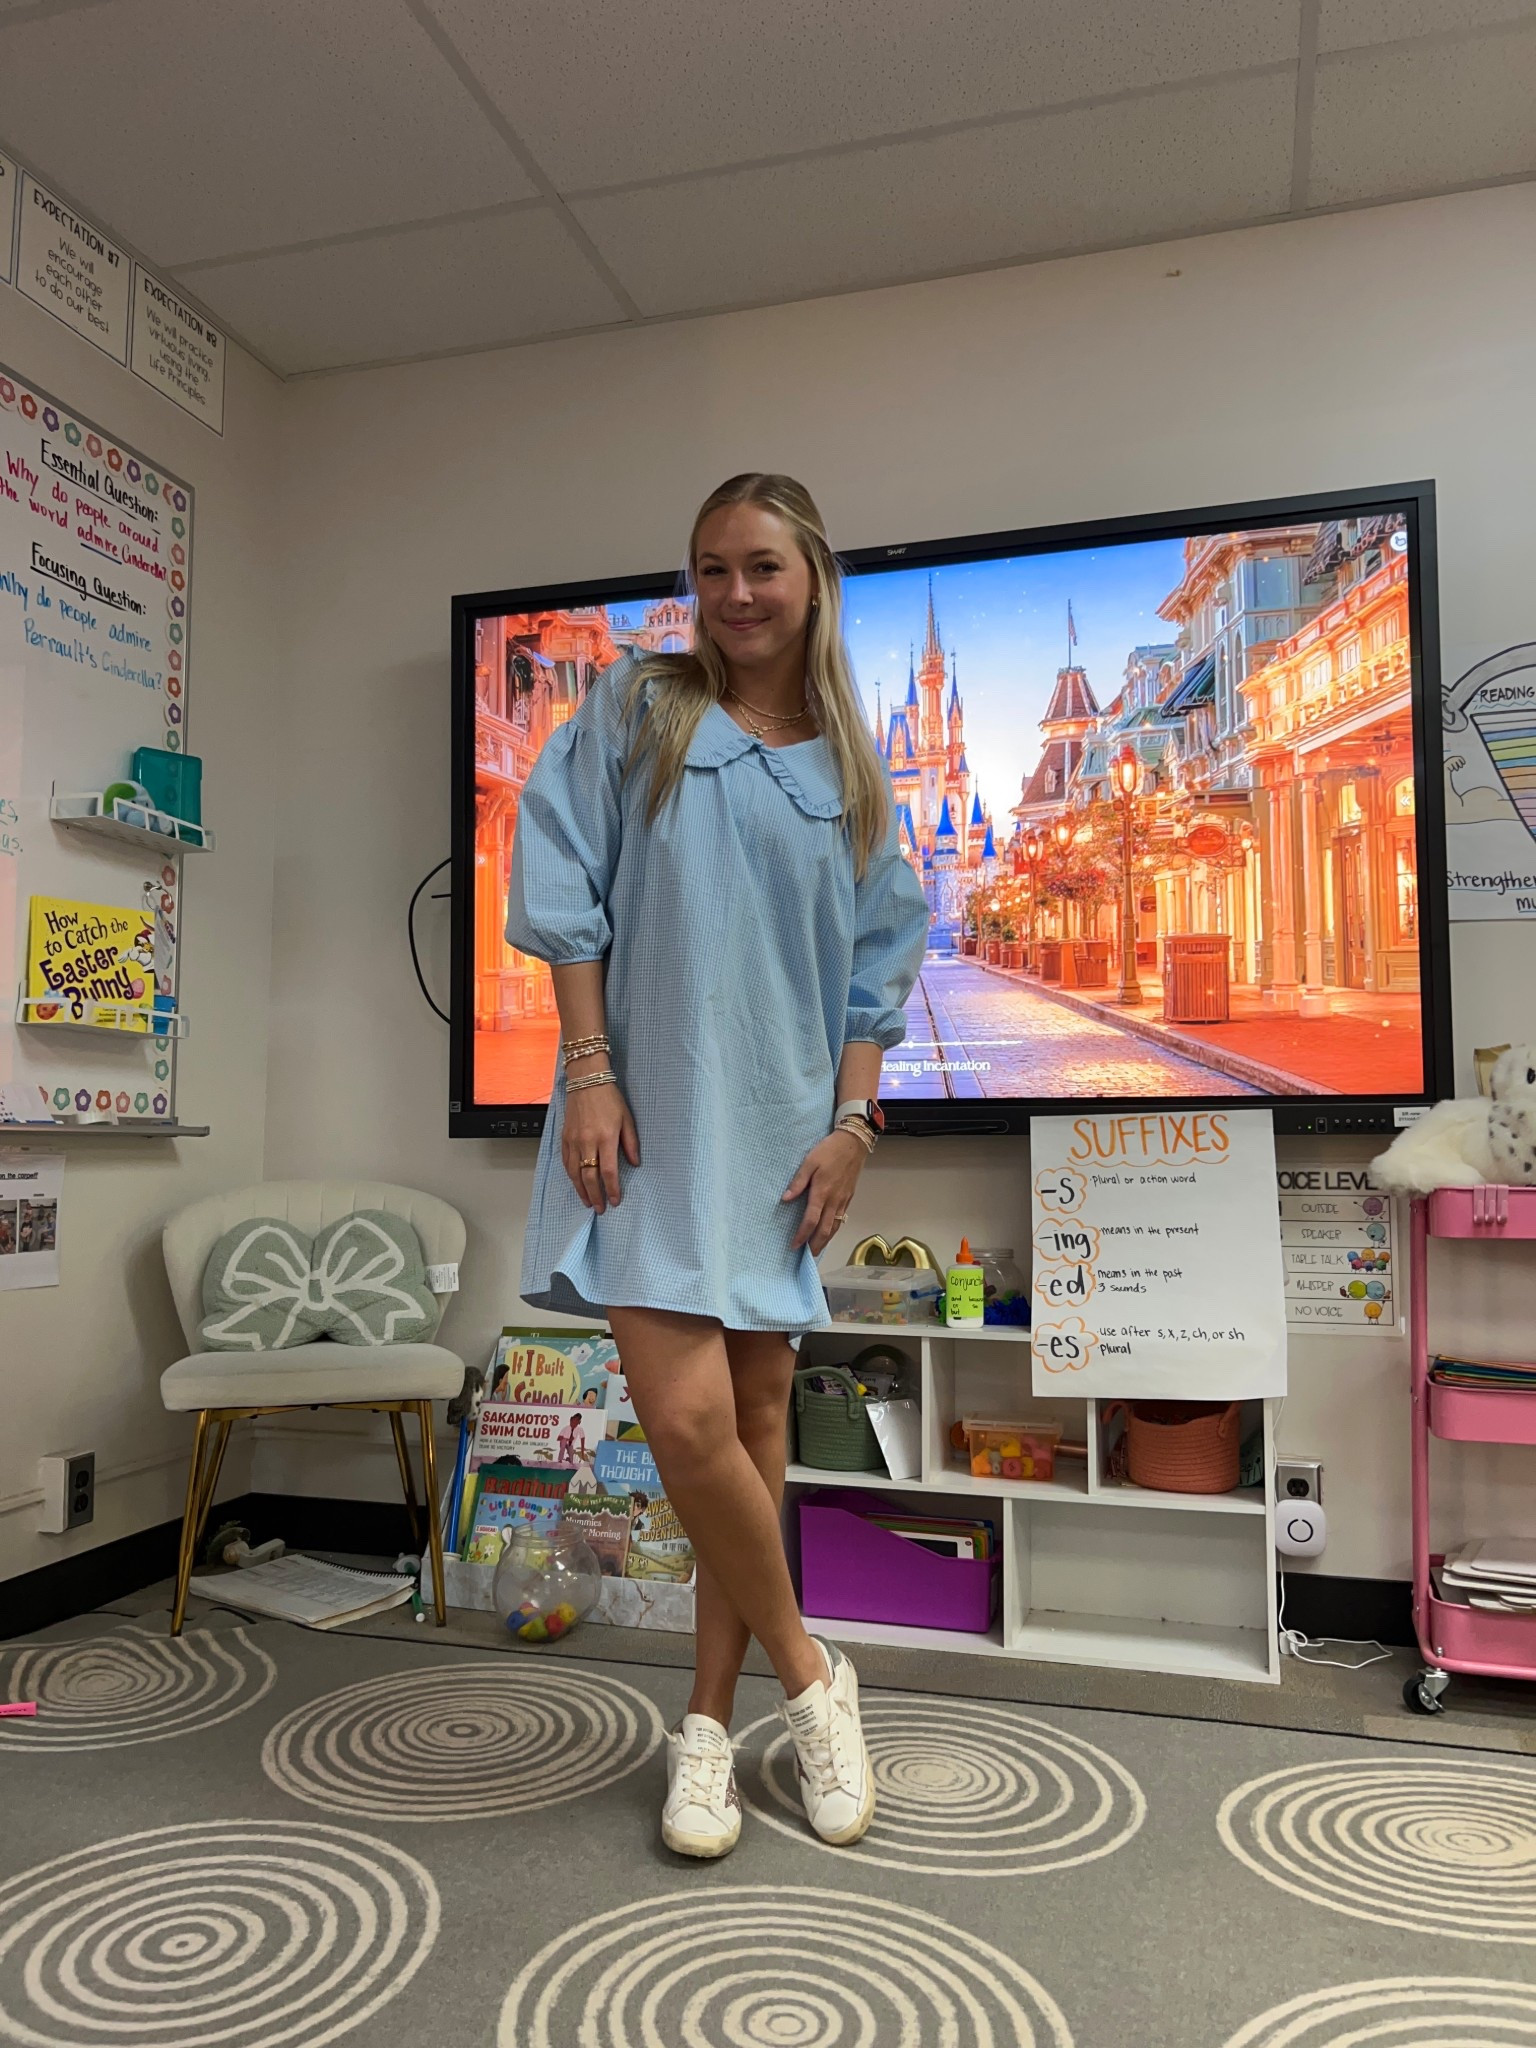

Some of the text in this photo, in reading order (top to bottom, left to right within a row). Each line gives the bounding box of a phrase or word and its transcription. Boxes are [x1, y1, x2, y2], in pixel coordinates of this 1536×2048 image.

[33, 188, 120, 268] EXPECTATION #7
[59, 236, 94, 274] We will
[48, 249, 102, 297] encourage
[46, 264, 102, 312] each other
[35, 269, 109, 334] to do our best
[144, 278, 217, 348] EXPECTATION #8
[147, 305, 213, 367] We will practice
[149, 327, 185, 361] virtuous
[159, 349, 199, 385] using the
[149, 354, 205, 405] Life Principles
[41, 438, 158, 523] Essential Question:
[6, 450, 159, 553] Why do people around
[0, 476, 166, 581] the world admire Cinderella?
[887, 547, 907, 556] SMART
[32, 541, 147, 616] Focusing Question:
[0, 571, 152, 652] Why do people admire
[24, 617, 162, 690] Perrault's Cinderella?
[1480, 685, 1535, 704] READING
[1447, 870, 1536, 896] Strengthe
[44, 910, 78, 935] How
[44, 916, 129, 956] to Catch the
[39, 946, 118, 991] Easter
[63, 966, 134, 1020] Bunny
[923, 1060, 991, 1071] Incantation
[1070, 1114, 1230, 1159] SUFFIXES
[1140, 1174, 1167, 1184] action
[1170, 1172, 1196, 1183] word
[1278, 1171, 1378, 1190] OICE LEV
[1301, 1203, 1339, 1214] OUTSIDE
[1101, 1226, 1131, 1235] means
[1133, 1226, 1143, 1235] in
[1148, 1226, 1161, 1235] the
[1165, 1222, 1199, 1238] present
[1301, 1229, 1341, 1240] SPEAKER
[1291, 1253, 1344, 1264] TABLE TALK
[1098, 1269, 1126, 1278] means
[1130, 1268, 1140, 1278] in
[1145, 1268, 1158, 1277] the
[1163, 1268, 1183, 1283] past
[1098, 1283, 1147, 1293] 3 sounds
[1296, 1280, 1334, 1291] WHISPER
[1295, 1305, 1343, 1317] NO VOICE
[1100, 1327, 1117, 1336] use
[1121, 1325, 1151, 1337] after
[1192, 1327, 1210, 1342] ch,
[1212, 1331, 1225, 1339] or
[1229, 1327, 1245, 1340] sh
[512, 1350, 564, 1376] If I Built
[529, 1379, 535, 1387] a
[482, 1411, 559, 1426] SAKAMOTO'S
[480, 1424, 550, 1439] SWIM CLUB
[616, 1449, 638, 1464] THE
[600, 1464, 653, 1482] THOUGHT
[489, 1499, 515, 1512] Little
[501, 1508, 516, 1518] Big
[646, 1498, 672, 1517] AWES
[565, 1516, 602, 1527] Mummies
[650, 1510, 679, 1530] ANIM
[589, 1528, 621, 1540] Morning
[638, 1522, 687, 1541] ADVENTUR
